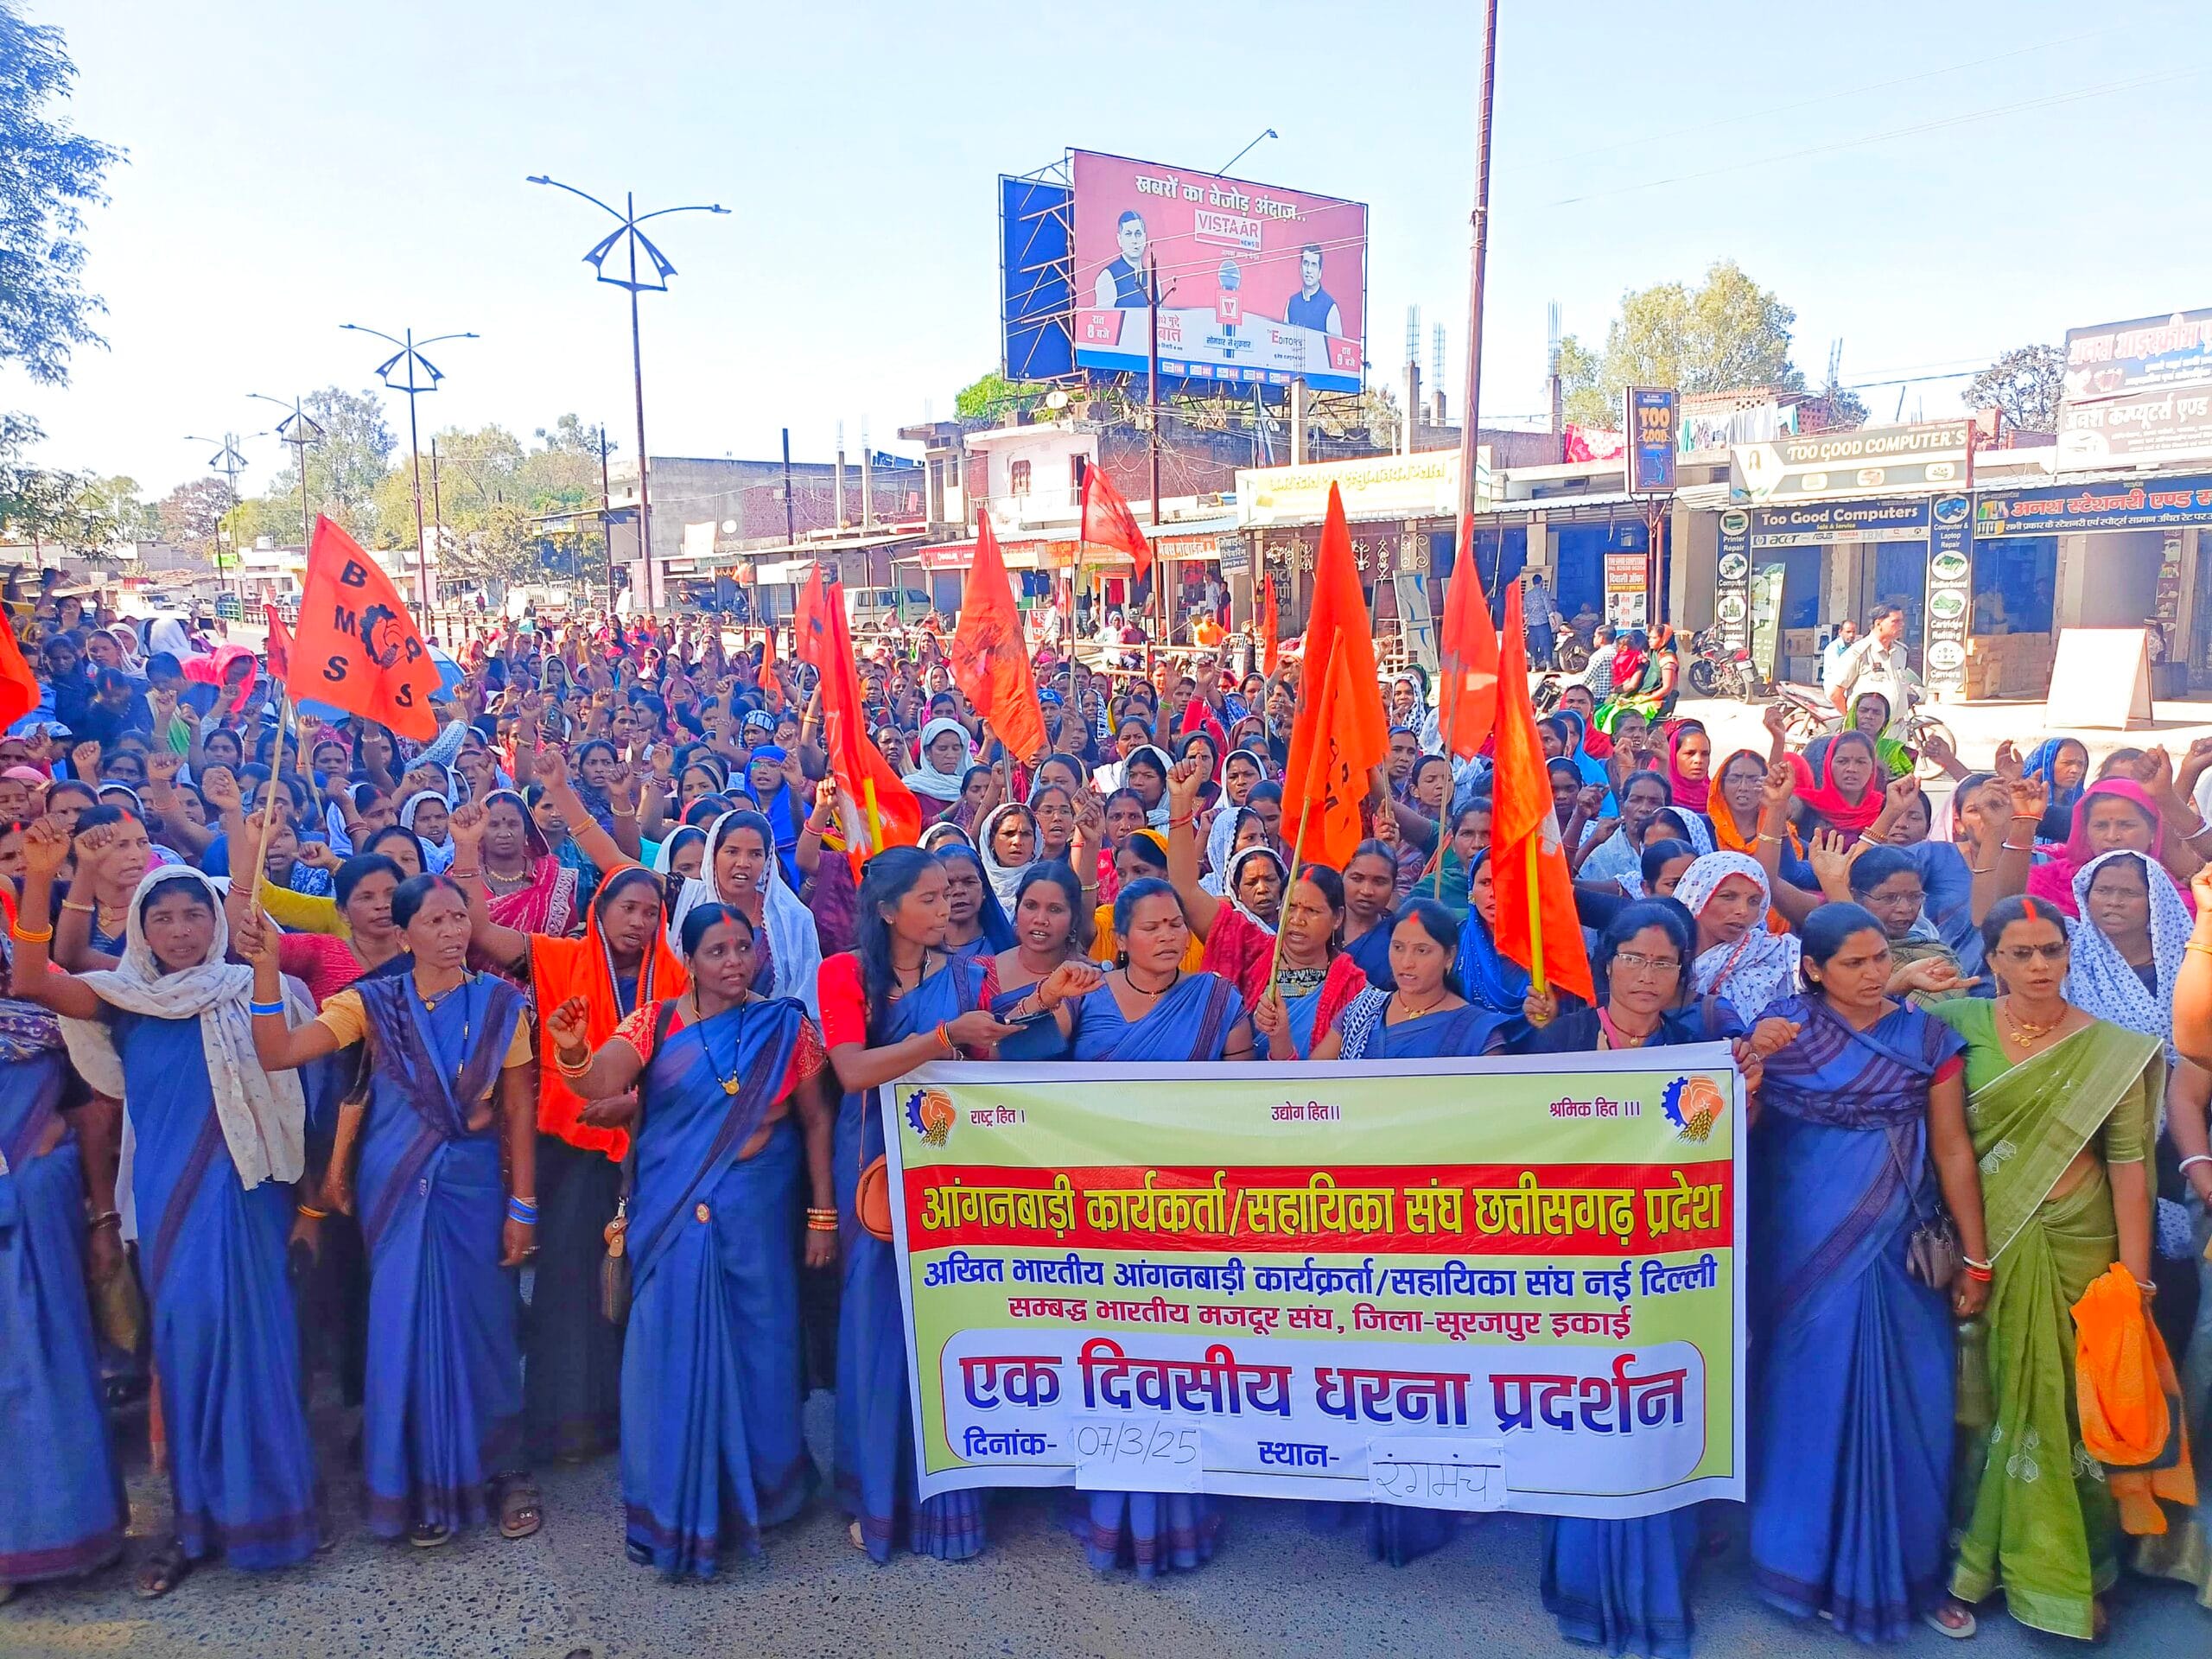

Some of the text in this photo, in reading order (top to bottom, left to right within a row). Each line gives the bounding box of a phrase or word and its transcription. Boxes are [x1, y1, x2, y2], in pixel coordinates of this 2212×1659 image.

[1135, 175, 1179, 198] खबरों
[1182, 183, 1205, 204] का
[1209, 183, 1250, 218] बेजोड़
[1198, 213, 1259, 238] VISTAAR
[1087, 324, 1095, 338] 8
[1227, 336, 1233, 346] से
[1337, 353, 1343, 366] 9
[1638, 407, 1670, 428] TOO
[1643, 429, 1668, 442] GOOD
[1786, 429, 1967, 462] TOO GOOD COMPUTER'S
[2067, 487, 2146, 513] स्टेशनरी
[2148, 490, 2194, 510] एण्ड
[1761, 506, 1918, 526] Too Good Computers
[2023, 521, 2044, 531] प्रकार
[2128, 515, 2156, 524] सामान
[1862, 531, 1884, 540] IBM
[1941, 541, 1960, 550] Repair
[340, 559, 368, 588] B
[334, 605, 356, 636] M
[322, 656, 349, 682] S
[970, 1109, 994, 1127] राष्ट्र
[995, 1105, 1016, 1123] हित
[1271, 1103, 1305, 1122] उद्योग
[1549, 1097, 1592, 1118] श्रमिक
[1595, 1096, 1618, 1117] हित
[920, 1173, 1076, 1239] आंगनबाड़ी
[1404, 1177, 1463, 1234] संघ
[1473, 1171, 1635, 1247] छत्तीसगढ़
[1645, 1171, 1723, 1238] प्रदेश
[1013, 1253, 1103, 1285] भारतीय
[1114, 1257, 1245, 1296] आंगनबाड़ी
[1526, 1264, 1573, 1296] संघ
[1583, 1259, 1631, 1302] नई
[1641, 1254, 1718, 1296] दिल्ली
[1007, 1297, 1087, 1322] सम्बद्ध
[1096, 1296, 1190, 1325] भारतीय
[1198, 1306, 1281, 1335] मजदूर
[1352, 1302, 1541, 1342] जिला-सूरजपुर
[1549, 1306, 1631, 1341] इकाई
[958, 1337, 1688, 1435] एक दिवसीय धरना प्रदर्शन
[963, 1426, 1057, 1457] दिनांक-
[1077, 1420, 1197, 1465] 07/3/25
[1257, 1440, 1339, 1467] स्थान-
